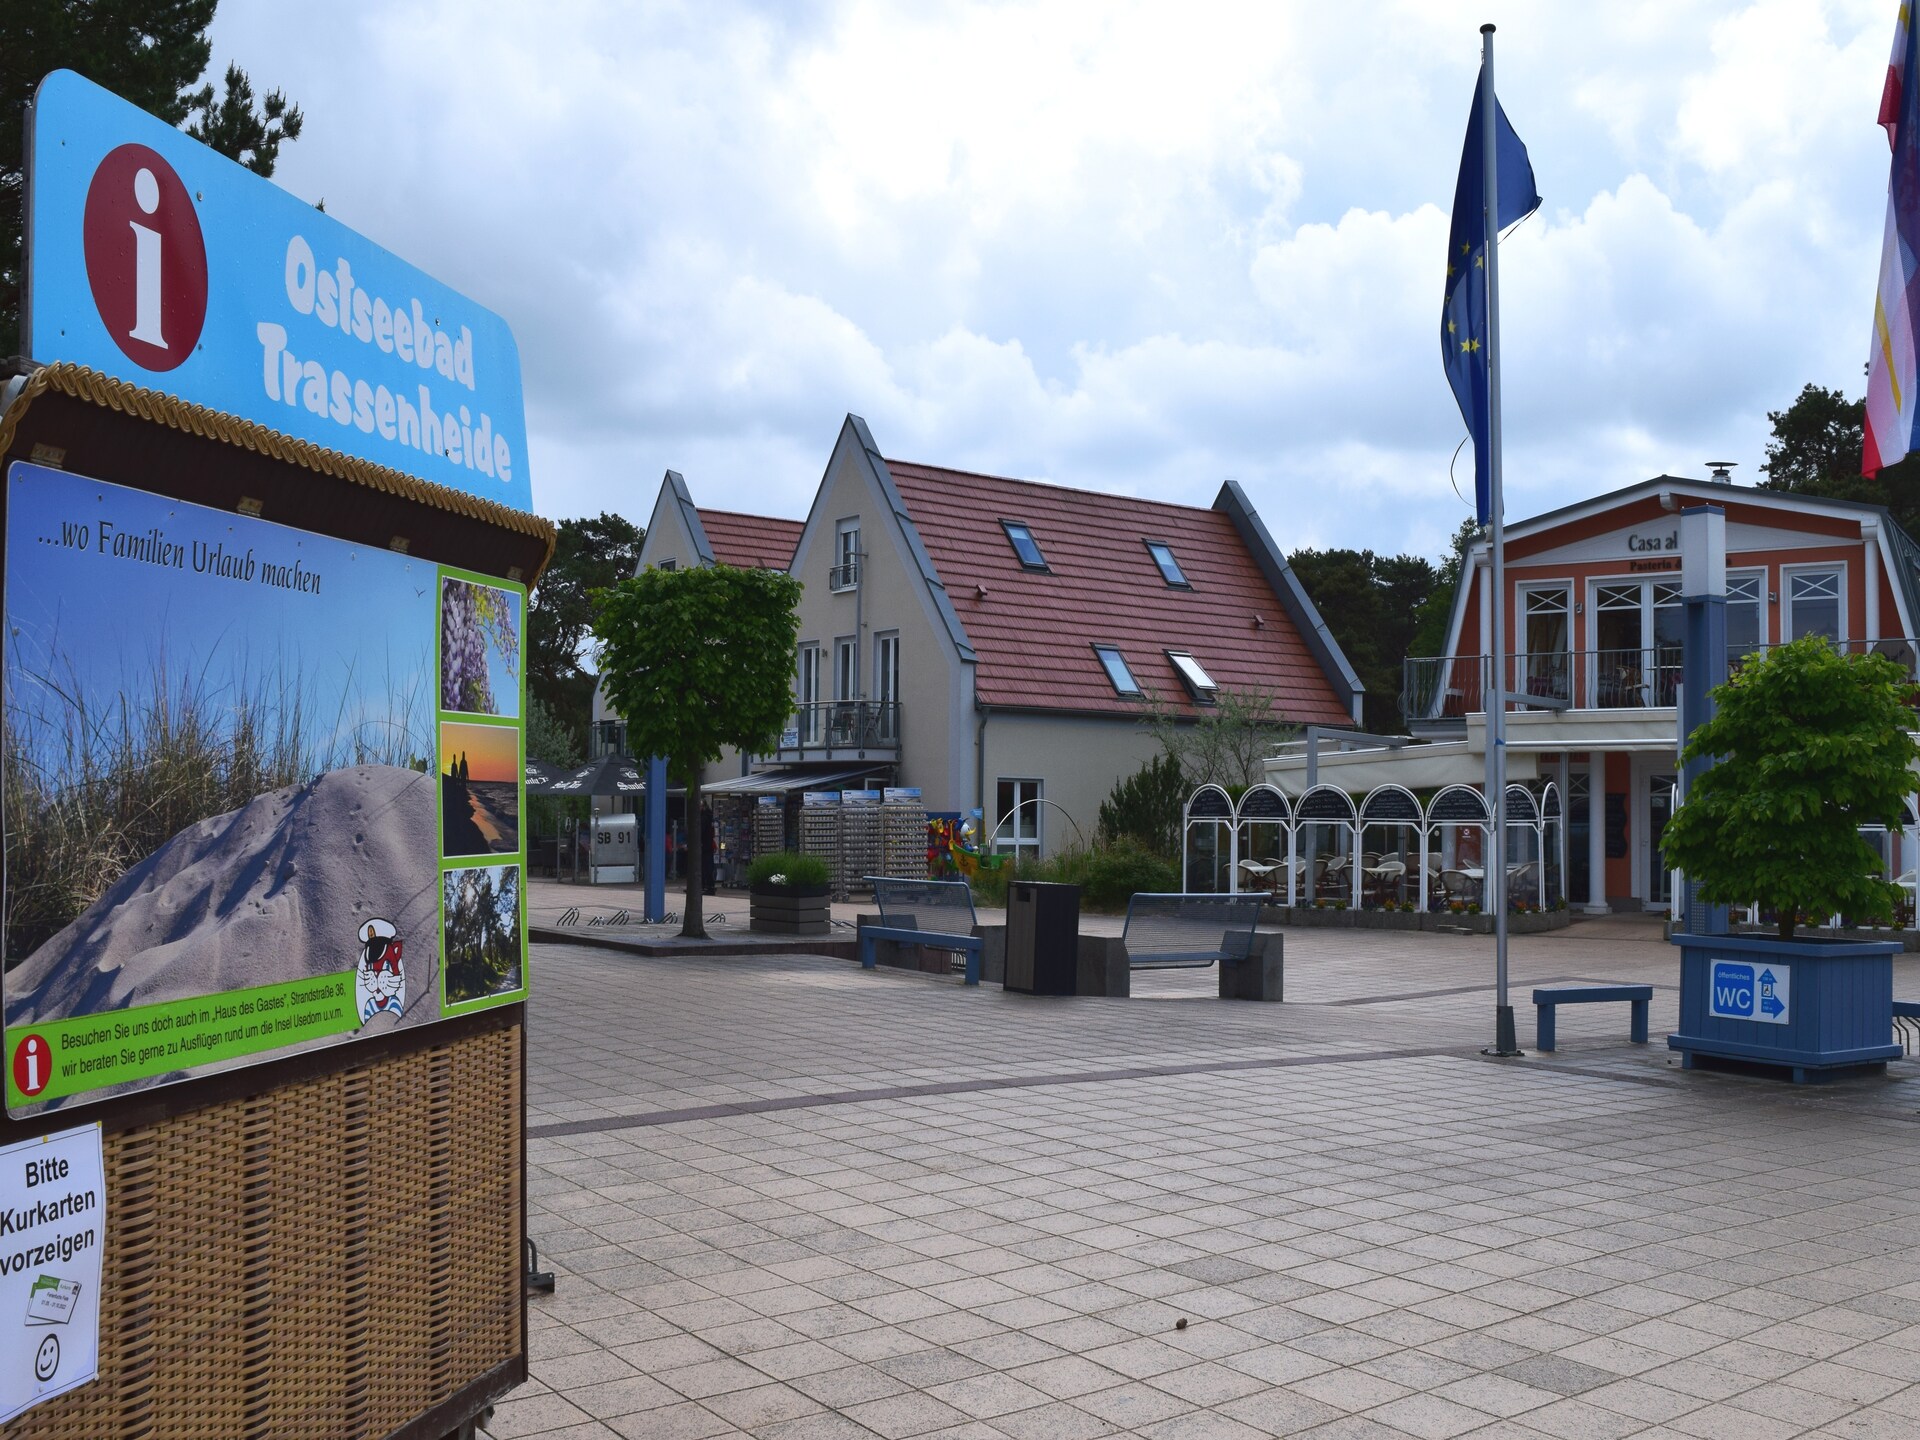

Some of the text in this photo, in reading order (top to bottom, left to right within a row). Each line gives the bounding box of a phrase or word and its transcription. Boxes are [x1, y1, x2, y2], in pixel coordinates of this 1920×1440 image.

[285, 235, 475, 391] Ostseebad
[257, 322, 512, 482] Trassenheide
[98, 520, 184, 569] Familien
[192, 540, 255, 582] Urlaub
[261, 559, 321, 595] machen
[1628, 530, 1678, 552] Casa al
[1630, 560, 1672, 571] Pasteria
[597, 831, 632, 845] SB 91
[61, 1029, 112, 1050] Besuchen
[114, 1023, 130, 1040] Sie
[132, 1022, 149, 1036] uns
[151, 1014, 174, 1033] doch
[176, 1010, 197, 1028] auch
[199, 1008, 210, 1024] im
[239, 1001, 255, 1016] des
[290, 985, 334, 1006] Strandstraße
[1716, 986, 1751, 1009] WC
[61, 1060, 77, 1077] wir
[80, 1054, 118, 1074] beraten
[120, 1048, 136, 1065] Sie
[138, 1044, 164, 1065] gerne
[167, 1042, 178, 1056] zu
[180, 1033, 223, 1050] Ausflügen
[224, 1025, 243, 1042] rund
[245, 1023, 259, 1038] um
[260, 1020, 273, 1036] die
[275, 1015, 293, 1032] Insel
[293, 1010, 322, 1028] Usedom
[25, 1156, 69, 1188] Bitte
[0, 1190, 95, 1236] Kurkarten
[0, 1229, 94, 1276] vorzeigen
